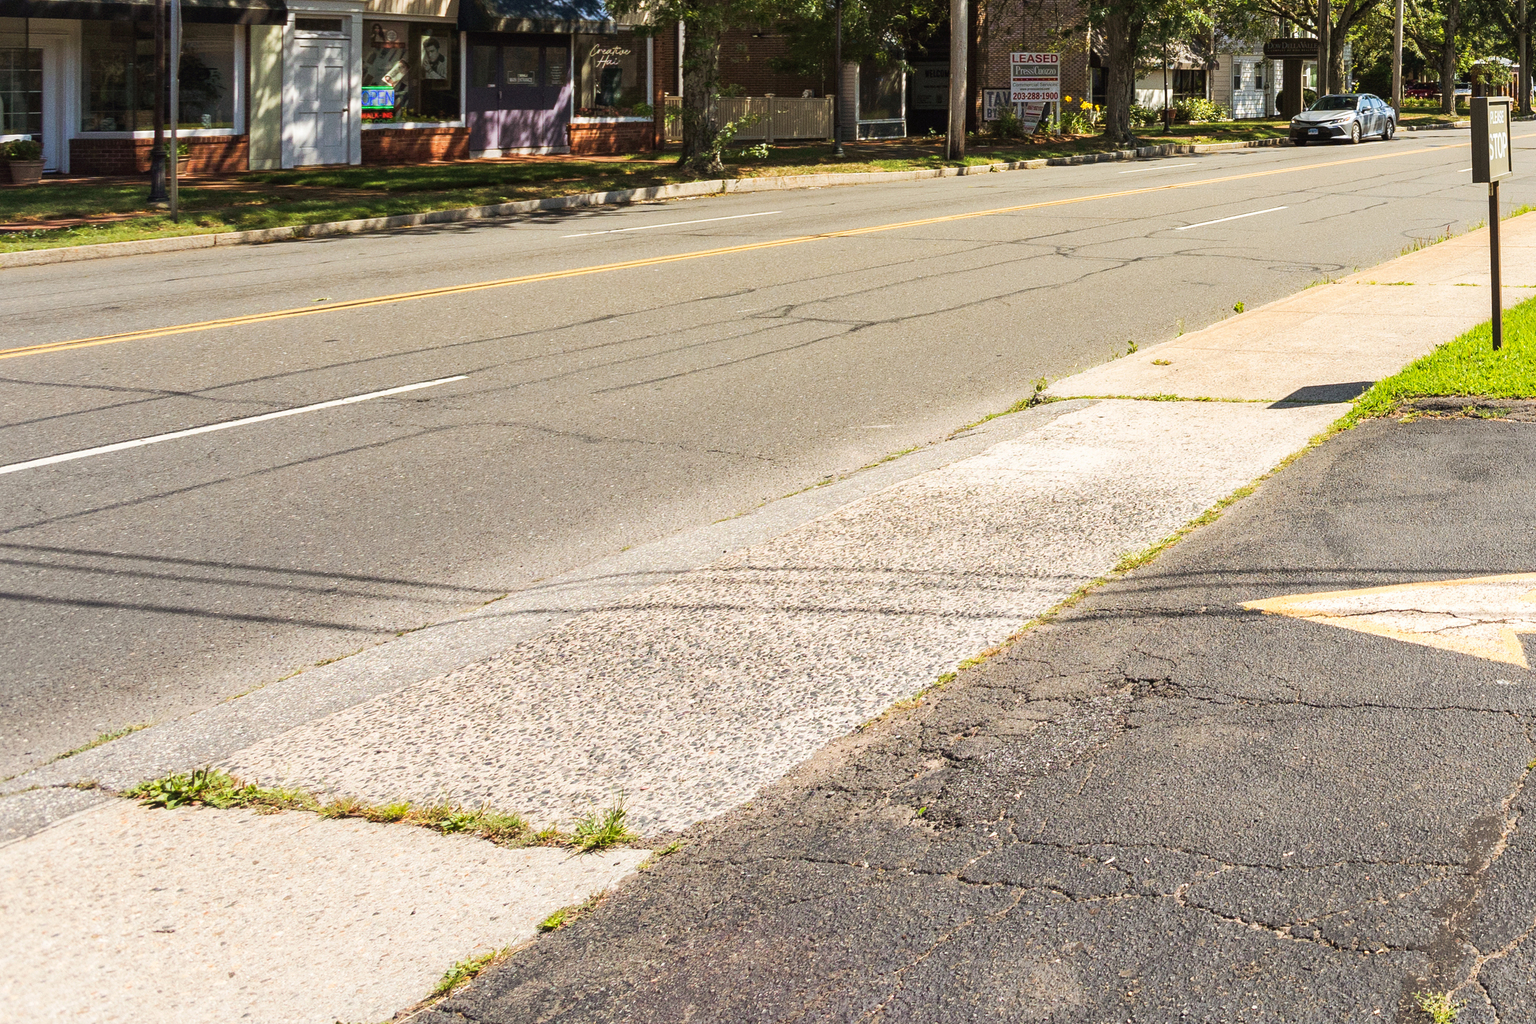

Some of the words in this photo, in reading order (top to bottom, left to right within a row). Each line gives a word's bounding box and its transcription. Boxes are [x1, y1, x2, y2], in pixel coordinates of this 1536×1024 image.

[589, 44, 631, 56] Creative
[1012, 54, 1058, 63] LEASED
[362, 90, 394, 106] OPEN
[1013, 92, 1058, 100] 203-288-1900
[1490, 111, 1504, 124] PLEASE
[1489, 132, 1507, 160] STOP
